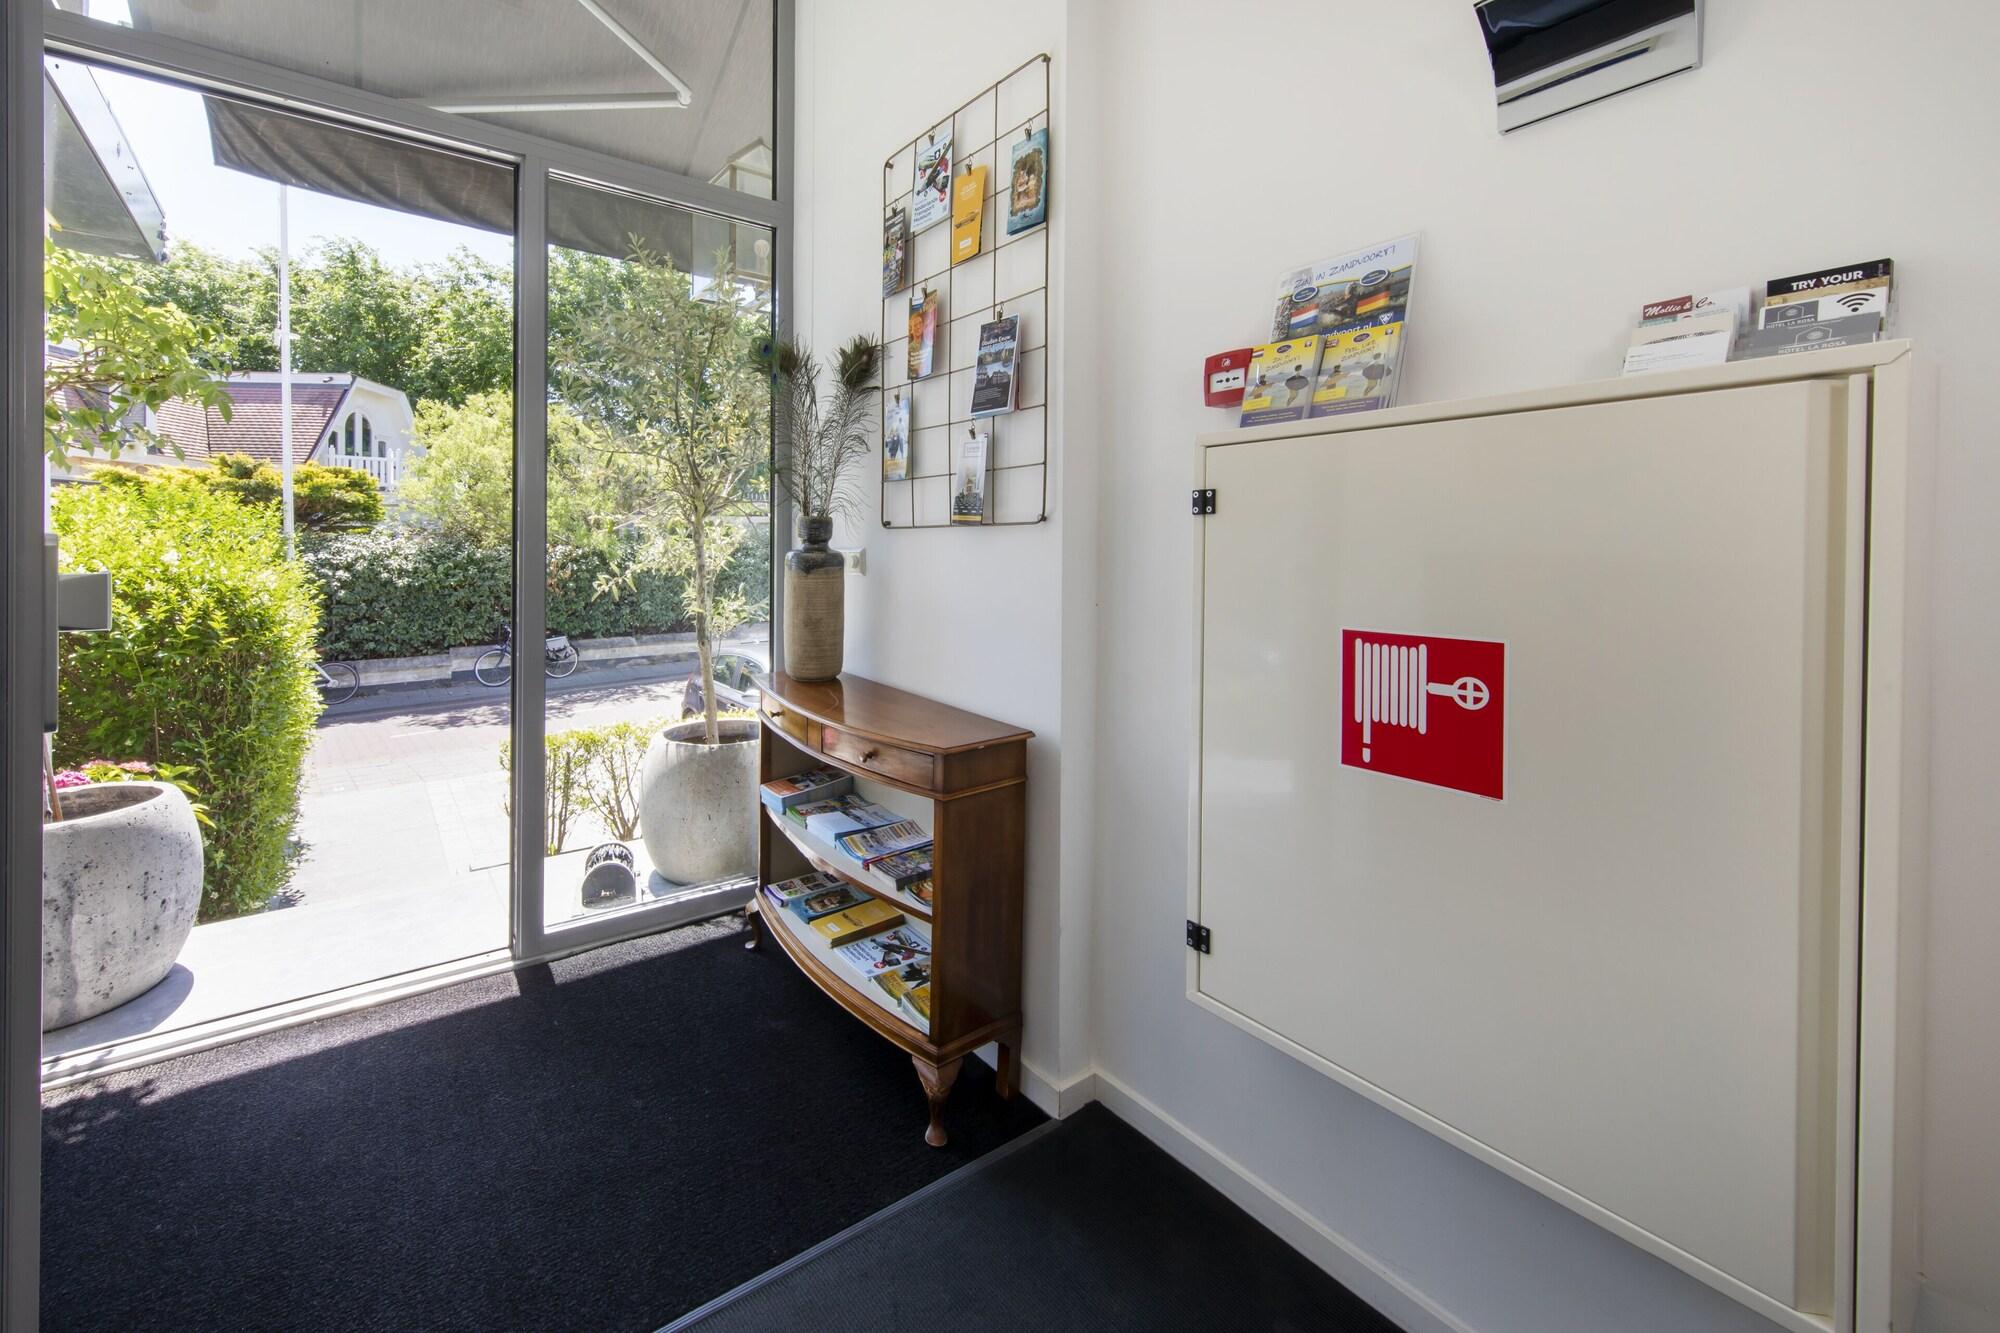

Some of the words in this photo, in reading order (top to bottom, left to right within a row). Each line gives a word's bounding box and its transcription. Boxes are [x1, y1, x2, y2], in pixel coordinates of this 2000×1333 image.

[1791, 279, 1817, 291] TRY
[1820, 270, 1864, 285] YOUR
[1644, 304, 1682, 317] Mollie
[1683, 301, 1693, 310] &
[1797, 317, 1815, 325] ROSA
[1778, 347, 1806, 355] HOTEL
[1821, 340, 1848, 349] ROSA
